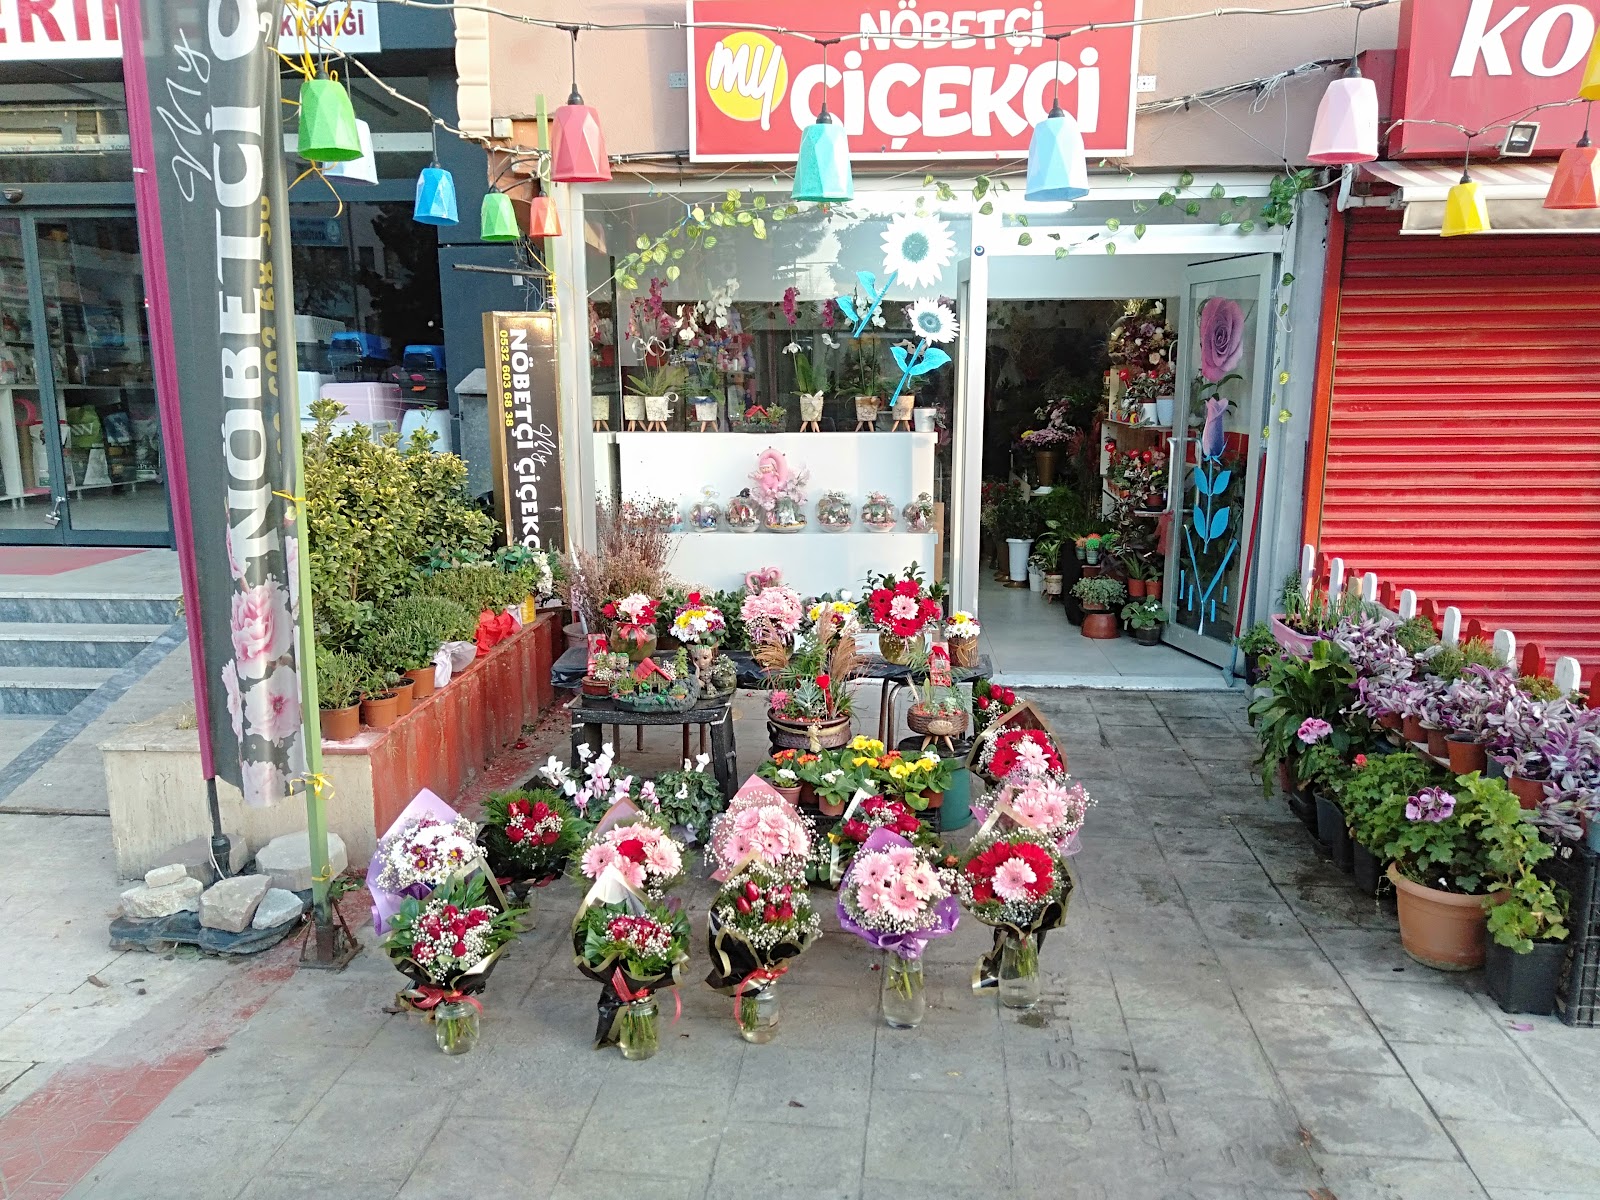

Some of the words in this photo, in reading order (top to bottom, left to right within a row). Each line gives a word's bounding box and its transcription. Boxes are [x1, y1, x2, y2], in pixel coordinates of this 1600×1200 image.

[0, 0, 120, 43] RI
[279, 8, 365, 37] KİNİĞİ
[859, 0, 1044, 55] NÖBETÇİ
[790, 46, 1100, 150] ÇİÇEKÇİ
[500, 329, 510, 362] 0532
[502, 364, 512, 389] 603
[509, 328, 539, 450] NÖBETÇİ
[503, 392, 513, 408] 68
[505, 411, 514, 427] 38
[514, 457, 541, 553] ÇİÇEKÇ
